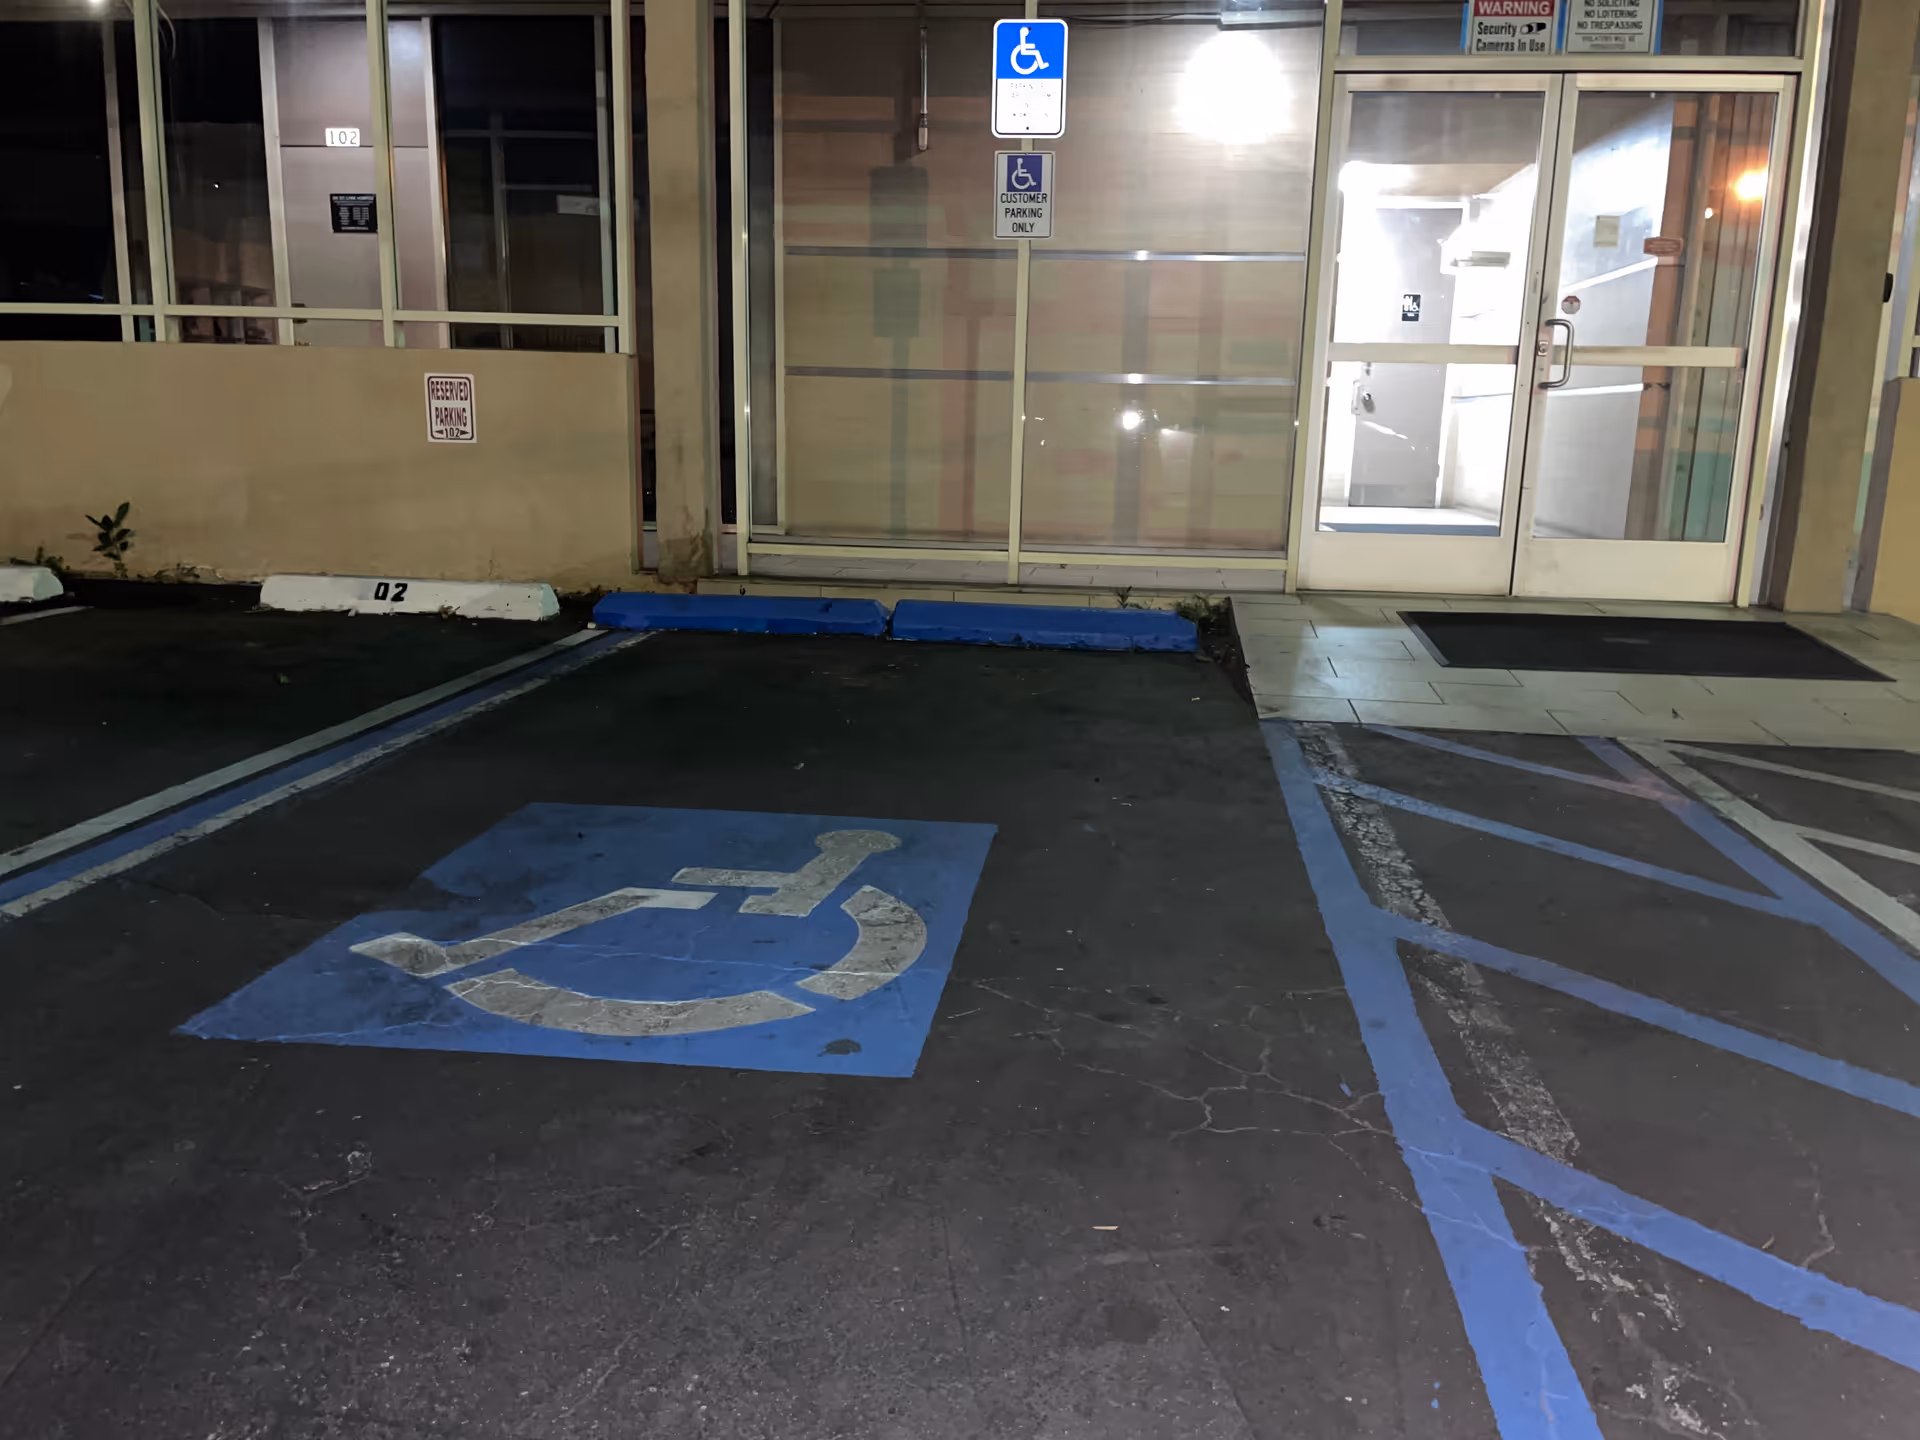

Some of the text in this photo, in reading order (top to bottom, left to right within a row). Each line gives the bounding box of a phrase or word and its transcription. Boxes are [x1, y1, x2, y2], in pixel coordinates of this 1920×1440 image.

[1479, 1, 1551, 15] WARNING
[1584, 10, 1637, 18] NO LOITERING
[1477, 22, 1517, 37] Security
[1577, 21, 1643, 29] NO TRESPASSING
[1476, 39, 1545, 52] Cameras In Use
[330, 130, 357, 145] 102
[1000, 193, 1048, 204] CUSTOMER
[1005, 207, 1043, 219] PARKING
[1012, 222, 1035, 233] ONLY
[430, 380, 469, 401] RESERVED
[434, 406, 467, 427] PARKING
[445, 427, 460, 438] 102
[374, 581, 408, 602] 02
